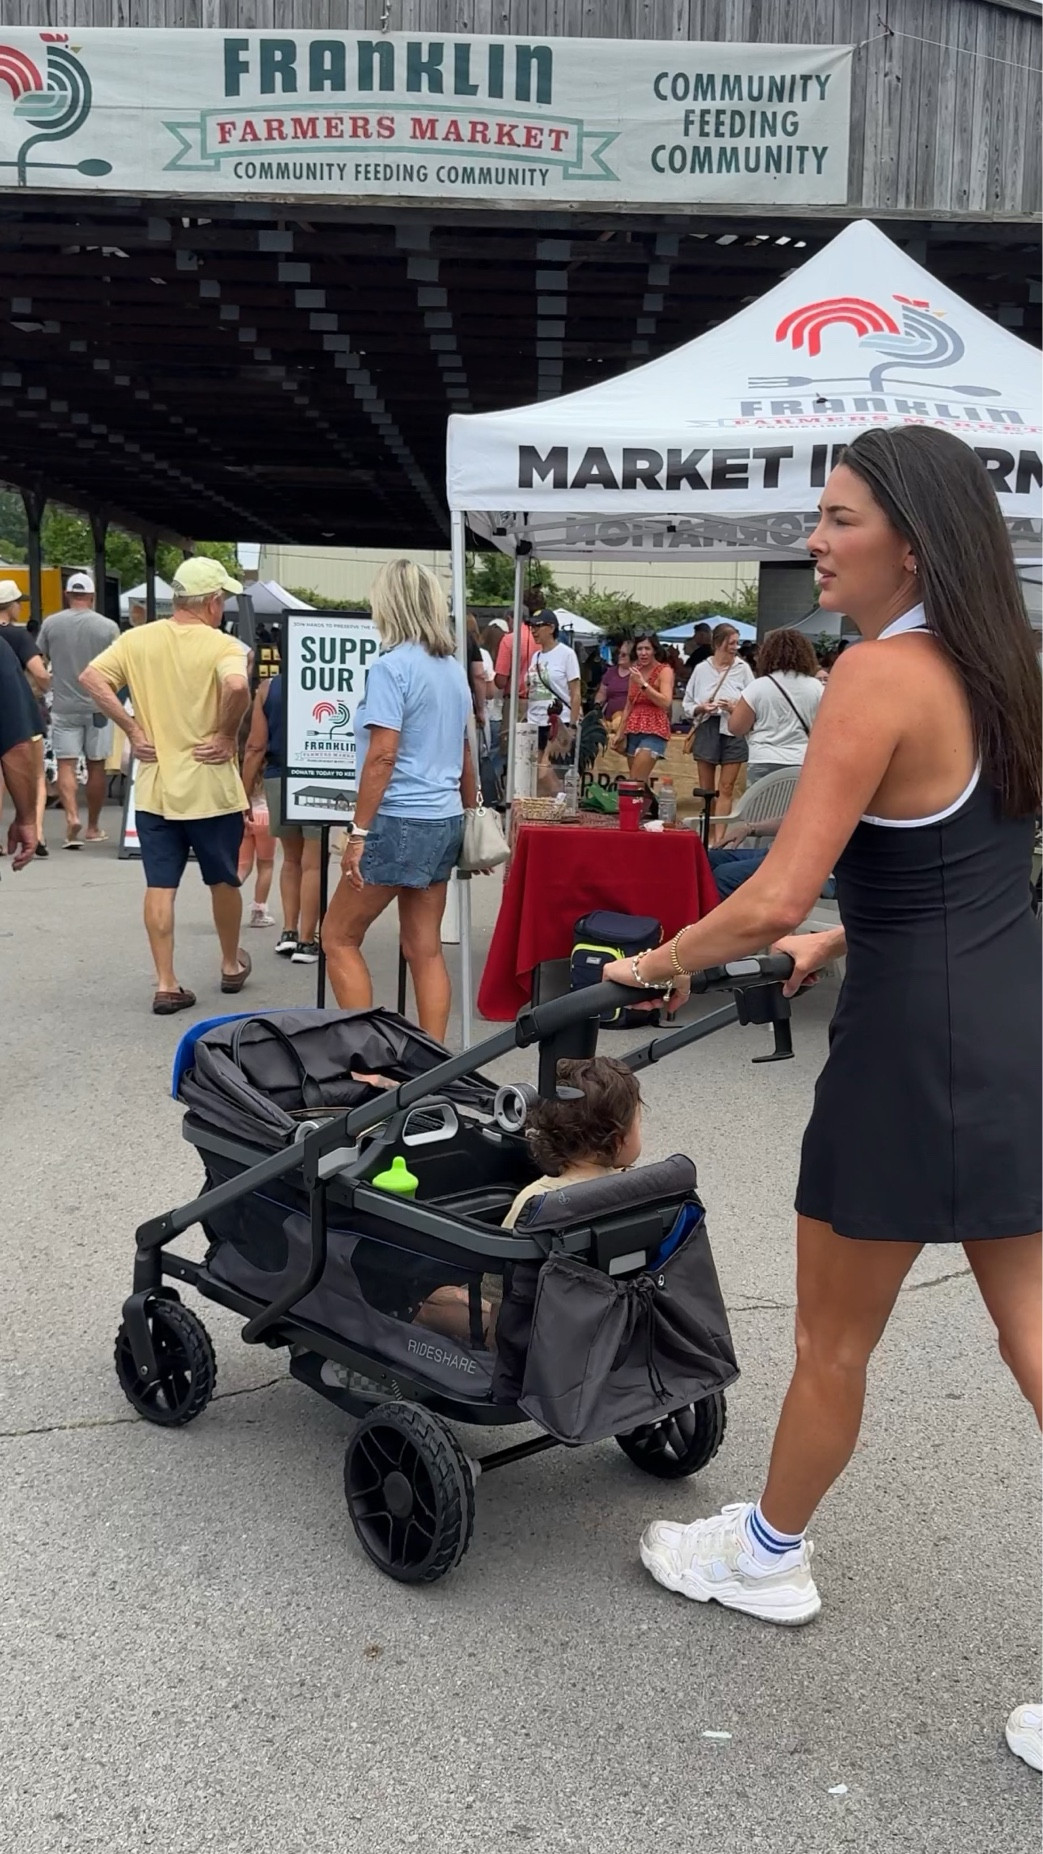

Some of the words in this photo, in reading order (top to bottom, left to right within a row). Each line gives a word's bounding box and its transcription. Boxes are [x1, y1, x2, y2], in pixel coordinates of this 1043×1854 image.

[223, 38, 554, 104] FRANKLIN
[653, 72, 832, 103] COMMUNITY
[217, 116, 396, 144] FARMERS
[410, 117, 569, 152] MARKET
[683, 109, 799, 138] FEEDING
[233, 161, 347, 182] COMMUNITY
[354, 162, 428, 184] FEEDING
[436, 165, 550, 187] COMMUNITY
[651, 144, 829, 175] COMMUNITY
[734, 413, 889, 425] FARMERS
[740, 397, 1025, 425] FRANKLIN
[518, 445, 794, 491] MARKET
[301, 636, 396, 665] SUPP
[301, 666, 353, 692] OUR
[304, 741, 356, 752] FRANKLIN
[408, 1339, 477, 1375] RIDESHARE
